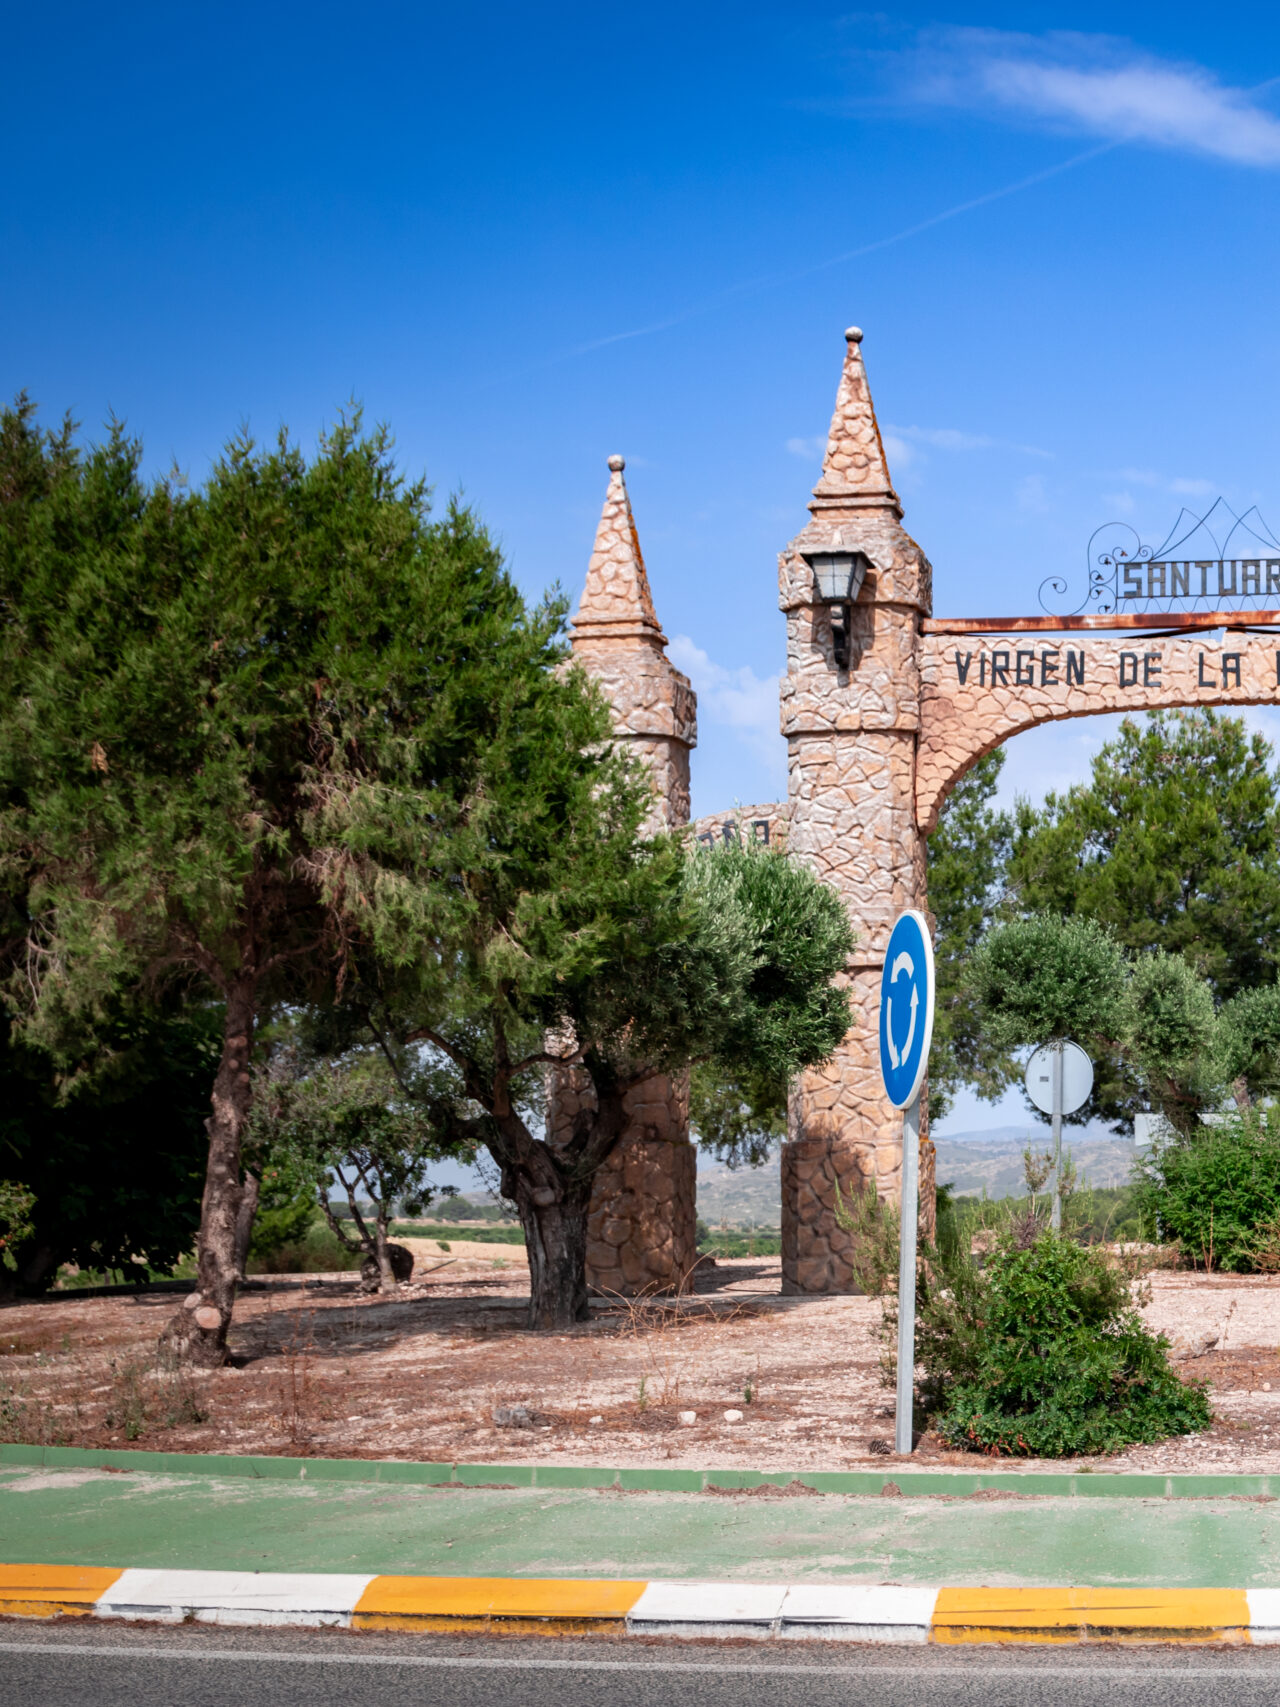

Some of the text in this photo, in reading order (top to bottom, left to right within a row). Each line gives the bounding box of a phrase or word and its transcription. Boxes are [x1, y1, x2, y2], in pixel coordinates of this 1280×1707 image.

[954, 650, 1085, 687] VIRGEN
[1118, 651, 1162, 688] DE
[1198, 651, 1241, 688] LA
